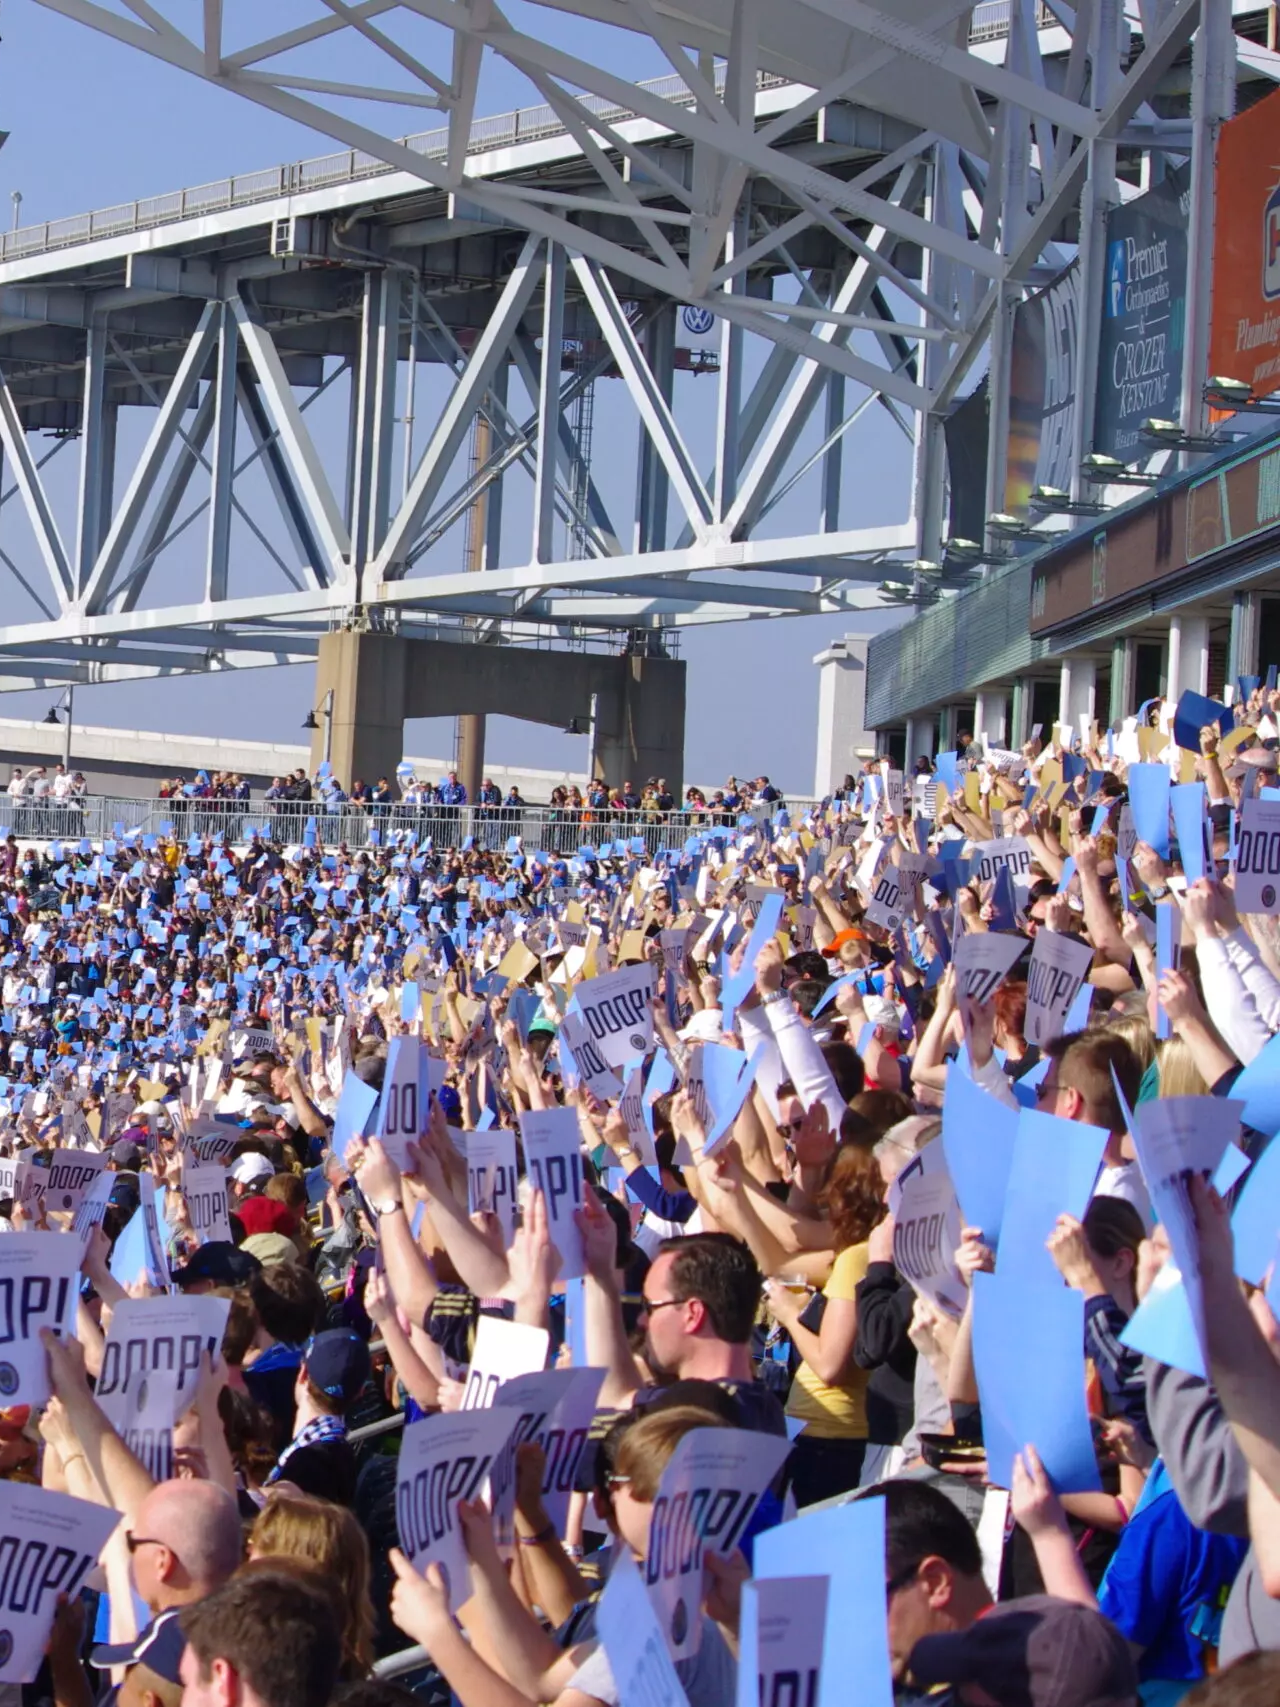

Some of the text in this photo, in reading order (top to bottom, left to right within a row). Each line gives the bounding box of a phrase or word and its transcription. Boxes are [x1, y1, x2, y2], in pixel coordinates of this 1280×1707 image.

[1125, 232, 1169, 283] Premier
[1125, 275, 1170, 316] Orthopaedics
[1113, 333, 1167, 389] CROZER
[1119, 372, 1170, 418] KEYSTONE
[583, 986, 651, 1040] DOOP!
[1028, 957, 1081, 1016] DOOP!
[399, 1455, 493, 1562] DOOP!
